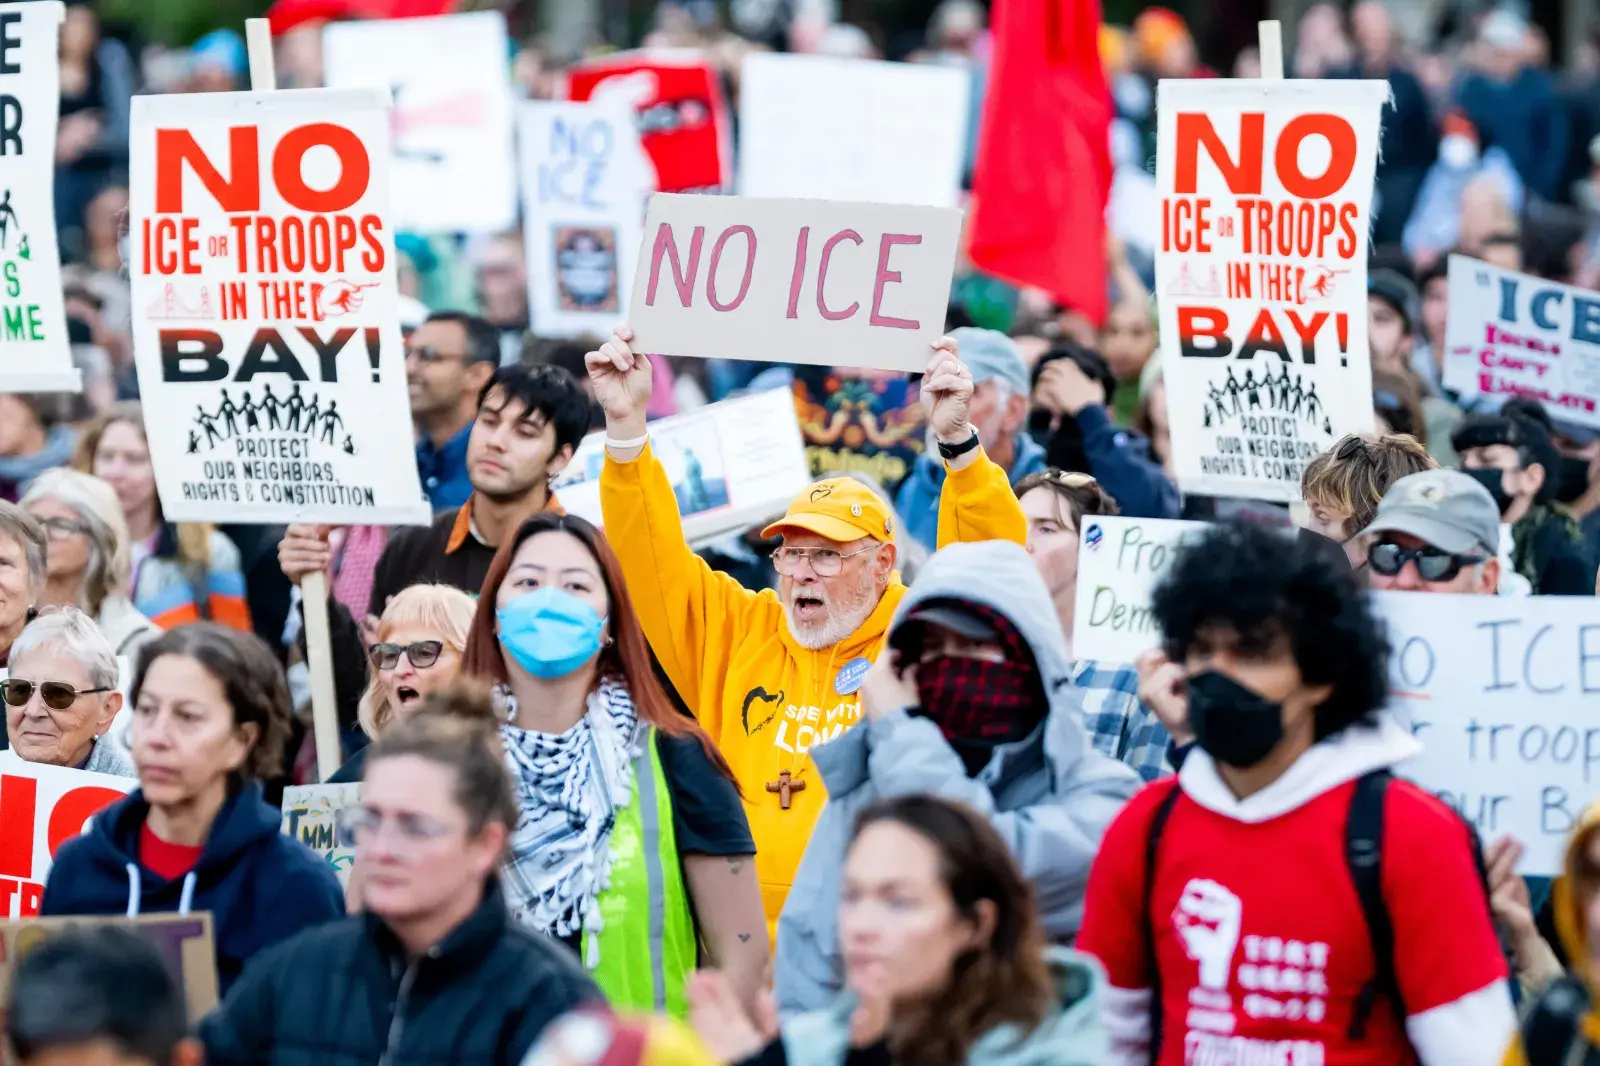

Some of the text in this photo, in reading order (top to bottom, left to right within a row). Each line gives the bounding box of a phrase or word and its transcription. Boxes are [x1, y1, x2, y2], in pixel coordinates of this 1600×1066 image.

[551, 114, 615, 160] NO
[1174, 112, 1357, 199] NO
[155, 122, 370, 213] NO
[538, 156, 608, 210] ICE
[142, 214, 385, 275] ICE OR TROOPS
[1162, 199, 1358, 259] ICE OR TROOPS
[646, 223, 922, 329] NO ICE
[1227, 262, 1292, 302] IN THE
[0, 304, 45, 341] ME
[220, 281, 307, 320] IN THE
[158, 326, 381, 383] BAY!
[1177, 306, 1348, 367] BAY!
[236, 438, 308, 458] PROTECT
[1200, 455, 1246, 476] RIGHTS
[1216, 435, 1242, 454] OUR
[182, 481, 239, 501] RIGHTS
[261, 483, 375, 506] CONSTITUTION
[204, 461, 340, 485] OUR NEIGHBORS,
[1400, 618, 1600, 694] O ICE
[774, 720, 854, 753] LOV
